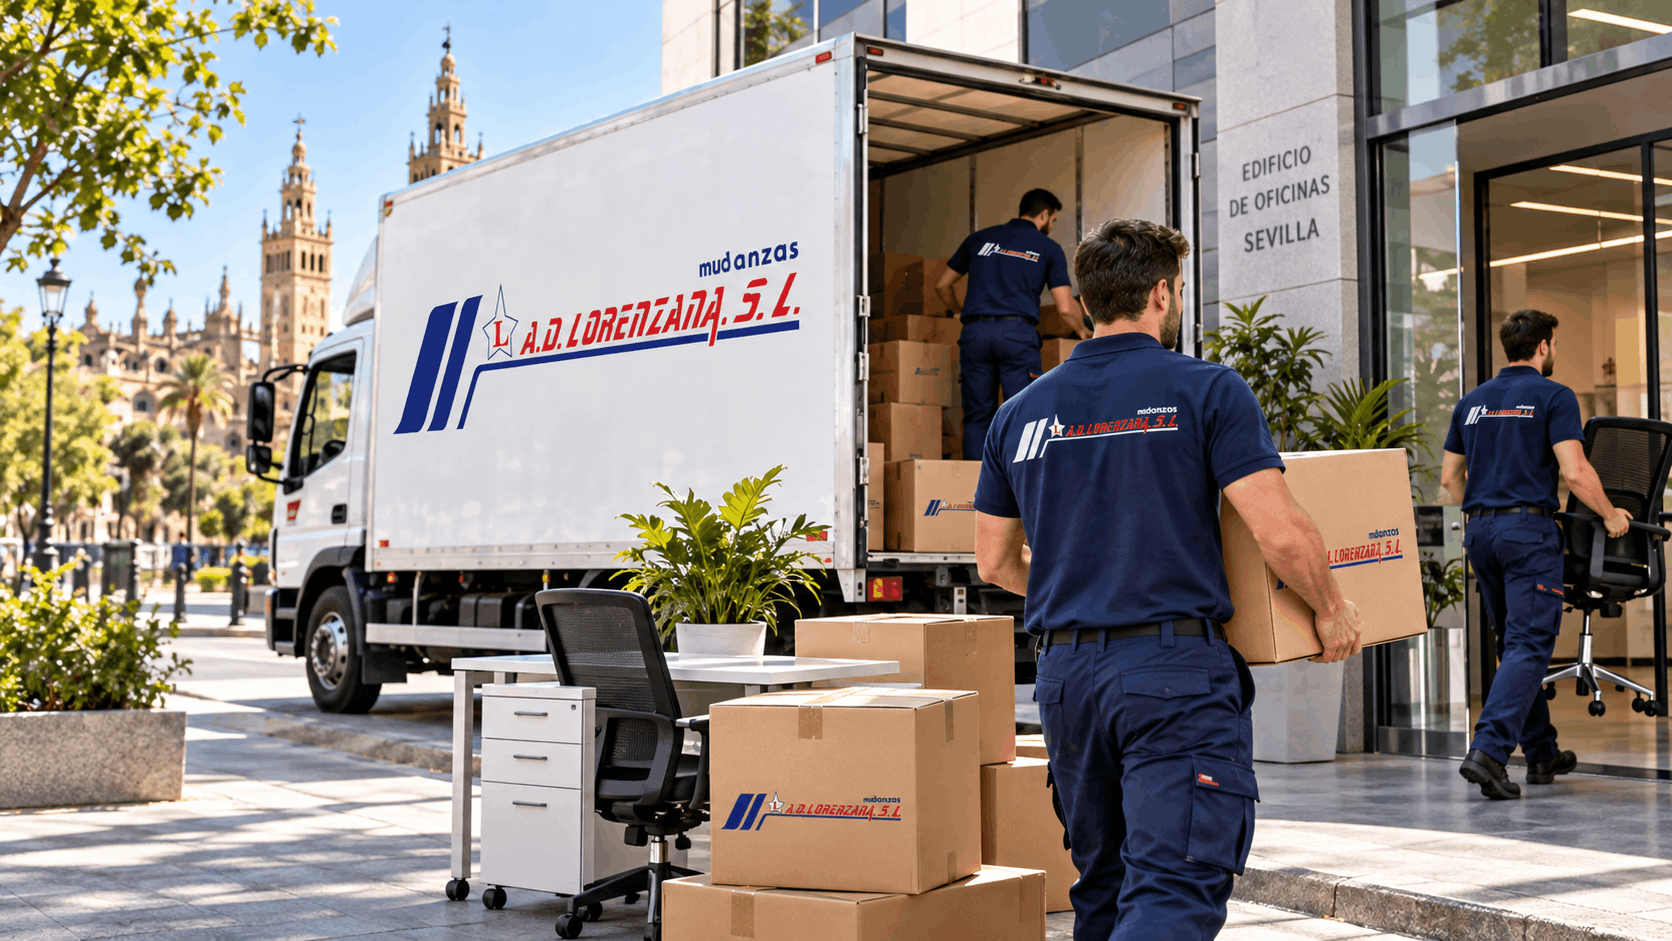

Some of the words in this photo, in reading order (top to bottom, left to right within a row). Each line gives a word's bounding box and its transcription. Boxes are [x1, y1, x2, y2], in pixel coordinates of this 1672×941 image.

[1242, 145, 1311, 182] EDIFICIO
[1229, 196, 1249, 218] DE
[1254, 174, 1330, 211] OFICINAS
[1244, 217, 1320, 253] SEVILLA
[699, 241, 799, 277] mudanzas
